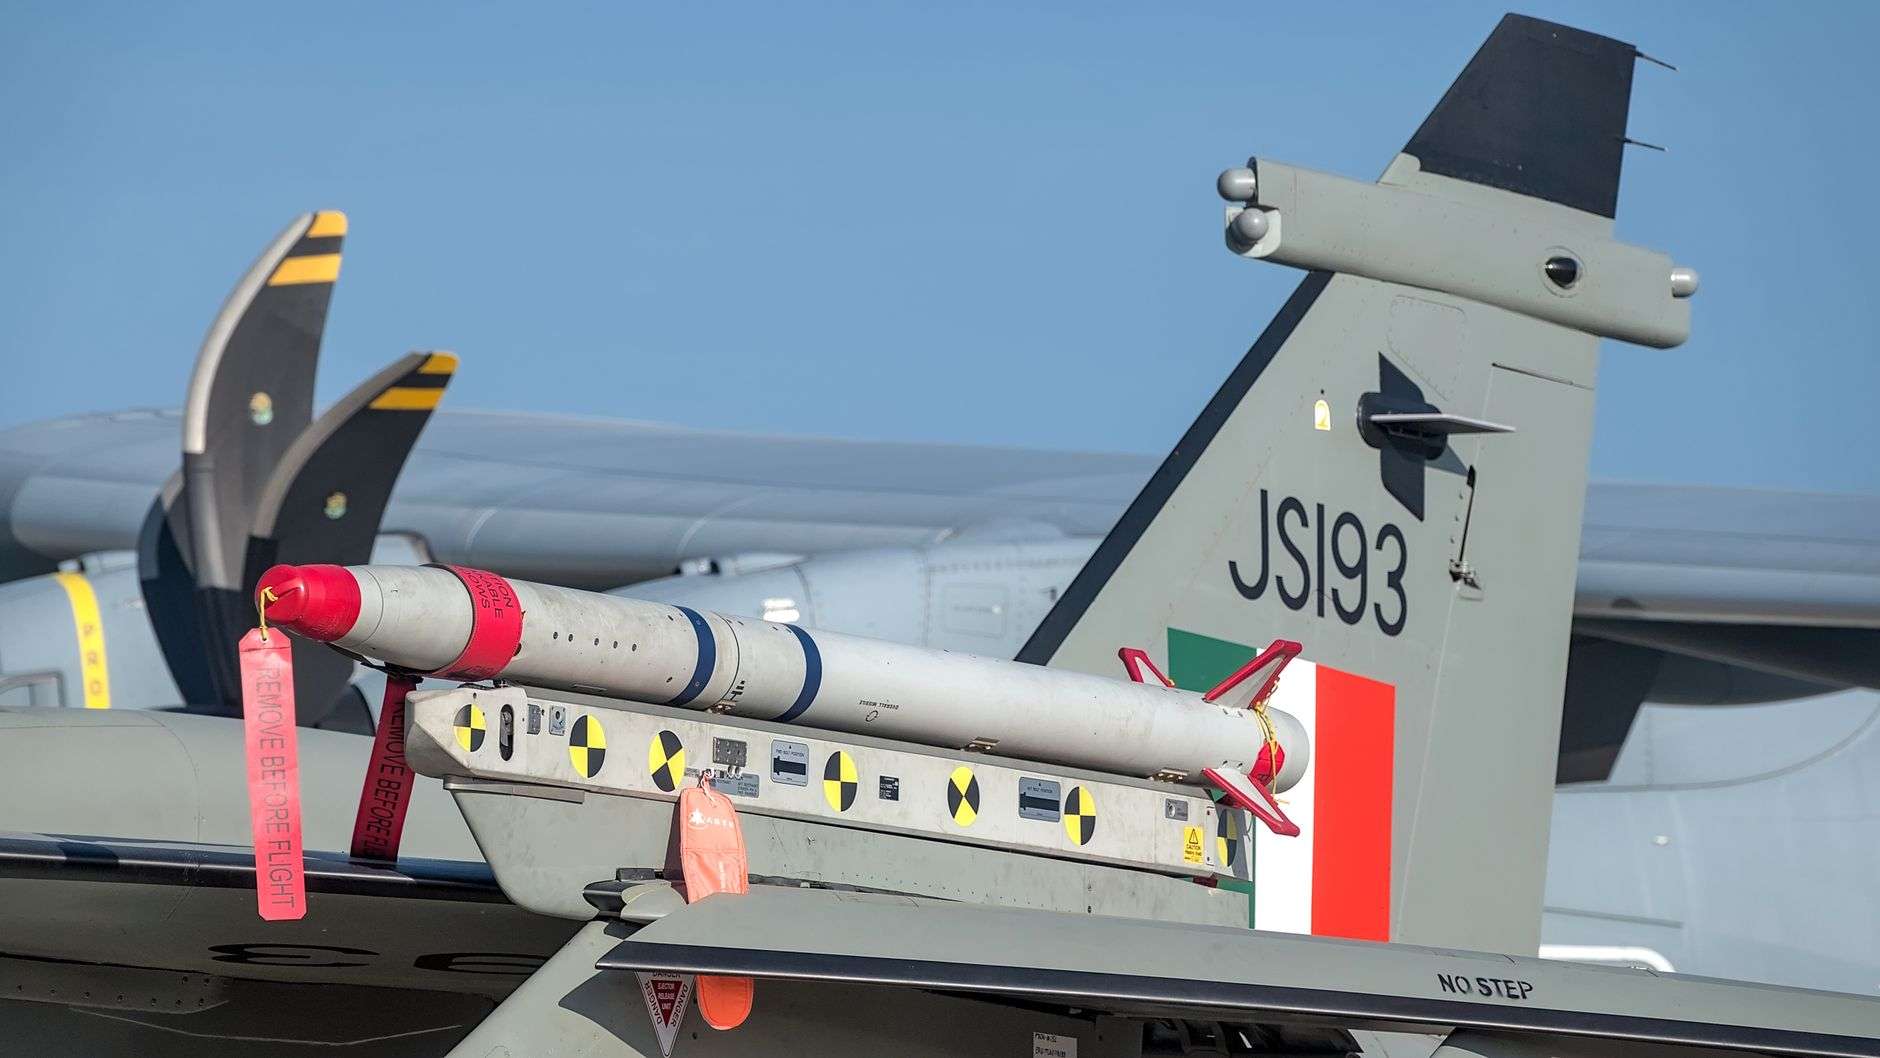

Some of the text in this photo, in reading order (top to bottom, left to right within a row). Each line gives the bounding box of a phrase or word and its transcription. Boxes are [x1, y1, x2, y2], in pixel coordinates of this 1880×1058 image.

[1229, 488, 1407, 636] JS193
[255, 667, 295, 909] REMOVE BEFORE FLIGHT
[366, 778, 401, 837] BEFORE
[644, 980, 662, 1025] DANGER
[661, 1002, 672, 1010] UNIT
[670, 983, 689, 1028] DANGER
[1437, 973, 1533, 1000] NO STEP
